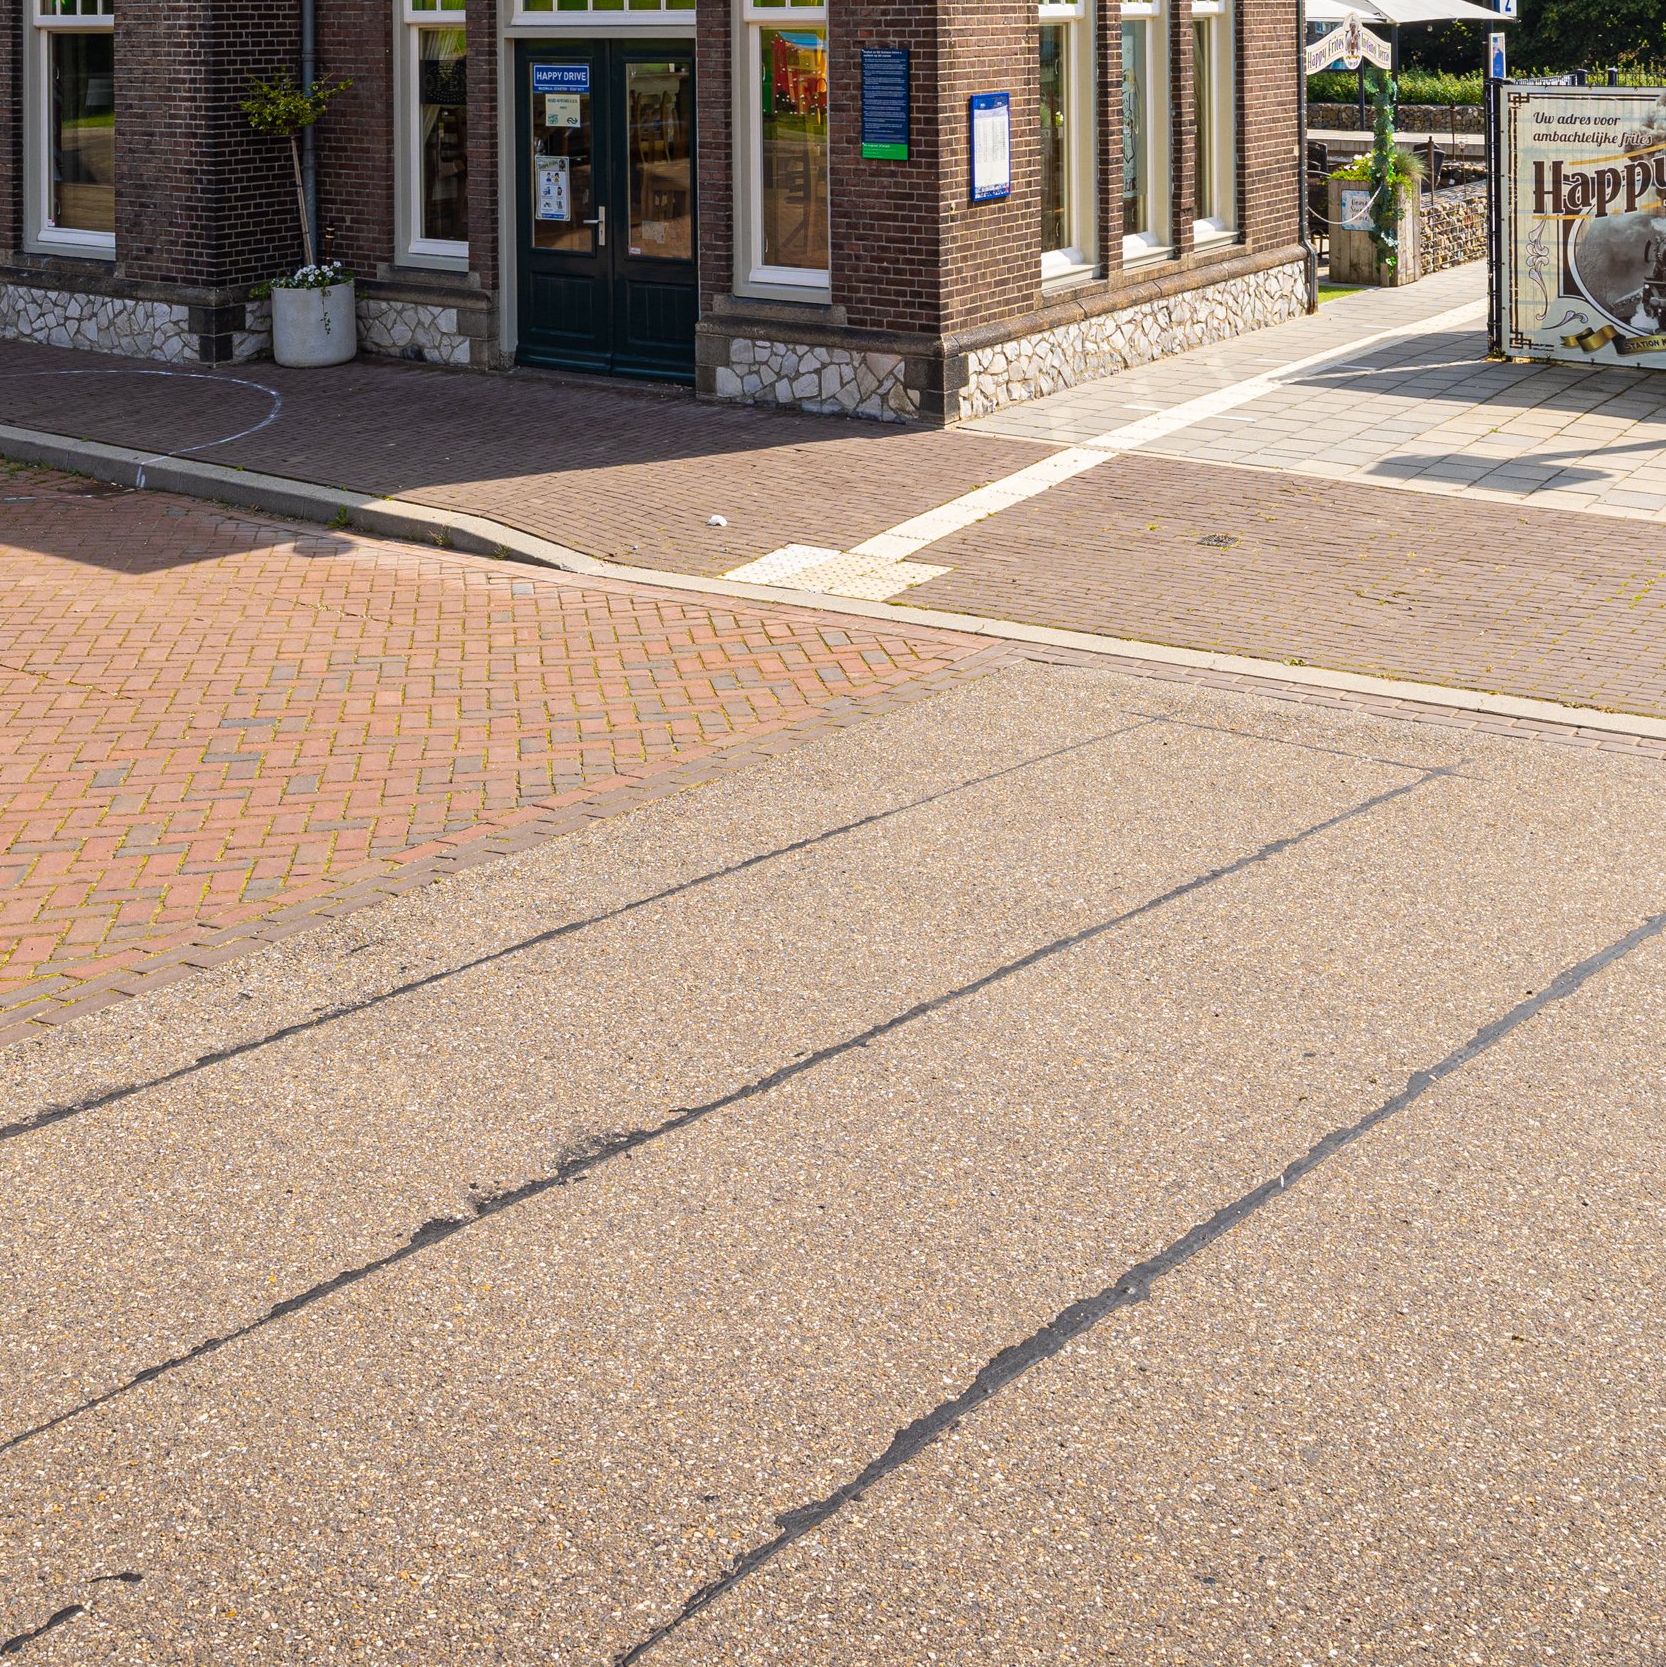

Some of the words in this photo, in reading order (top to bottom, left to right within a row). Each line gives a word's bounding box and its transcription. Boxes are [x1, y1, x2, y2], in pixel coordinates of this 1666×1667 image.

[1307, 46, 1327, 69] Happy
[536, 71, 562, 81] HAPPY
[563, 72, 586, 81] DRIVE
[1533, 111, 1554, 124] Uw
[1557, 113, 1591, 125] adres
[1593, 116, 1621, 126] voor
[1533, 131, 1618, 147] ambachtelijke
[1618, 132, 1652, 147] frites
[1625, 339, 1660, 350] STATION
